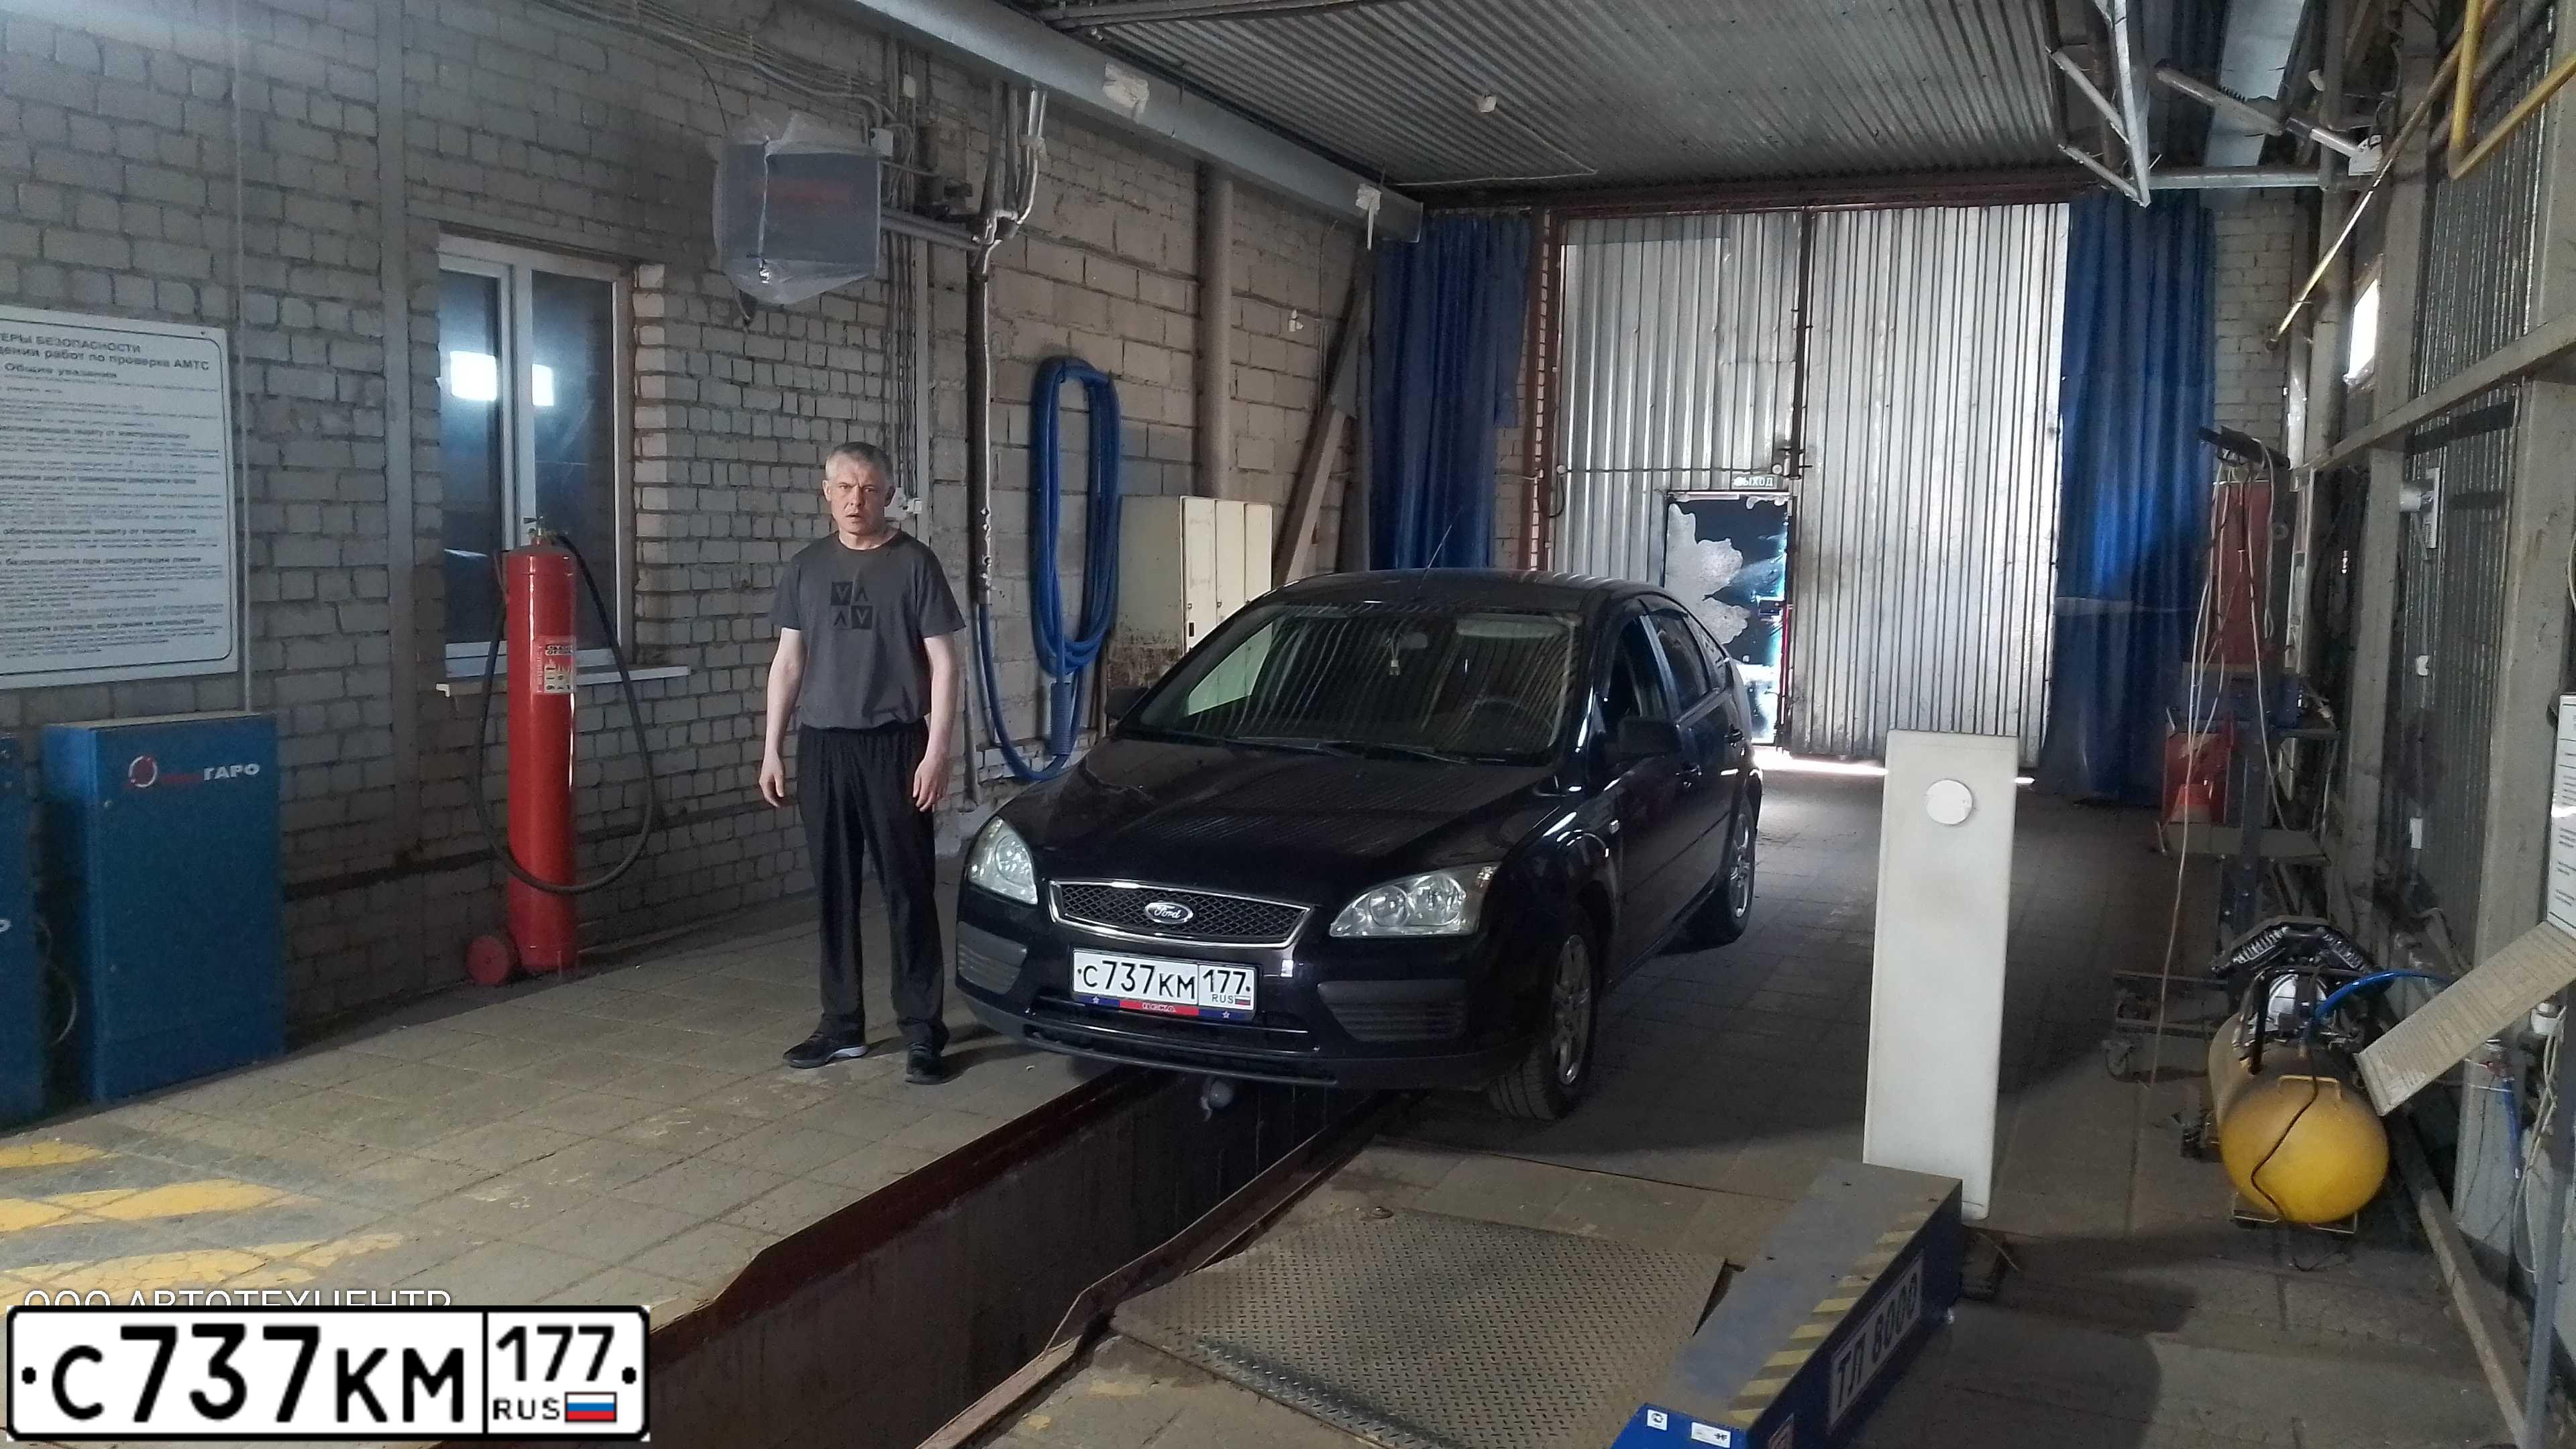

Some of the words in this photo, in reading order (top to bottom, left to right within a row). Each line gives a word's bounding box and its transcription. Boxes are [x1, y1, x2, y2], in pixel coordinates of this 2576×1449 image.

[89, 354, 105, 362] по
[174, 360, 210, 371] АМТС
[1733, 477, 1774, 487] ЫХОД
[203, 763, 260, 781] ГАРО
[1153, 906, 1181, 919] Ford
[1203, 969, 1246, 995] 177
[1212, 995, 1234, 1004] RUS
[1872, 1273, 1919, 1364] 8000
